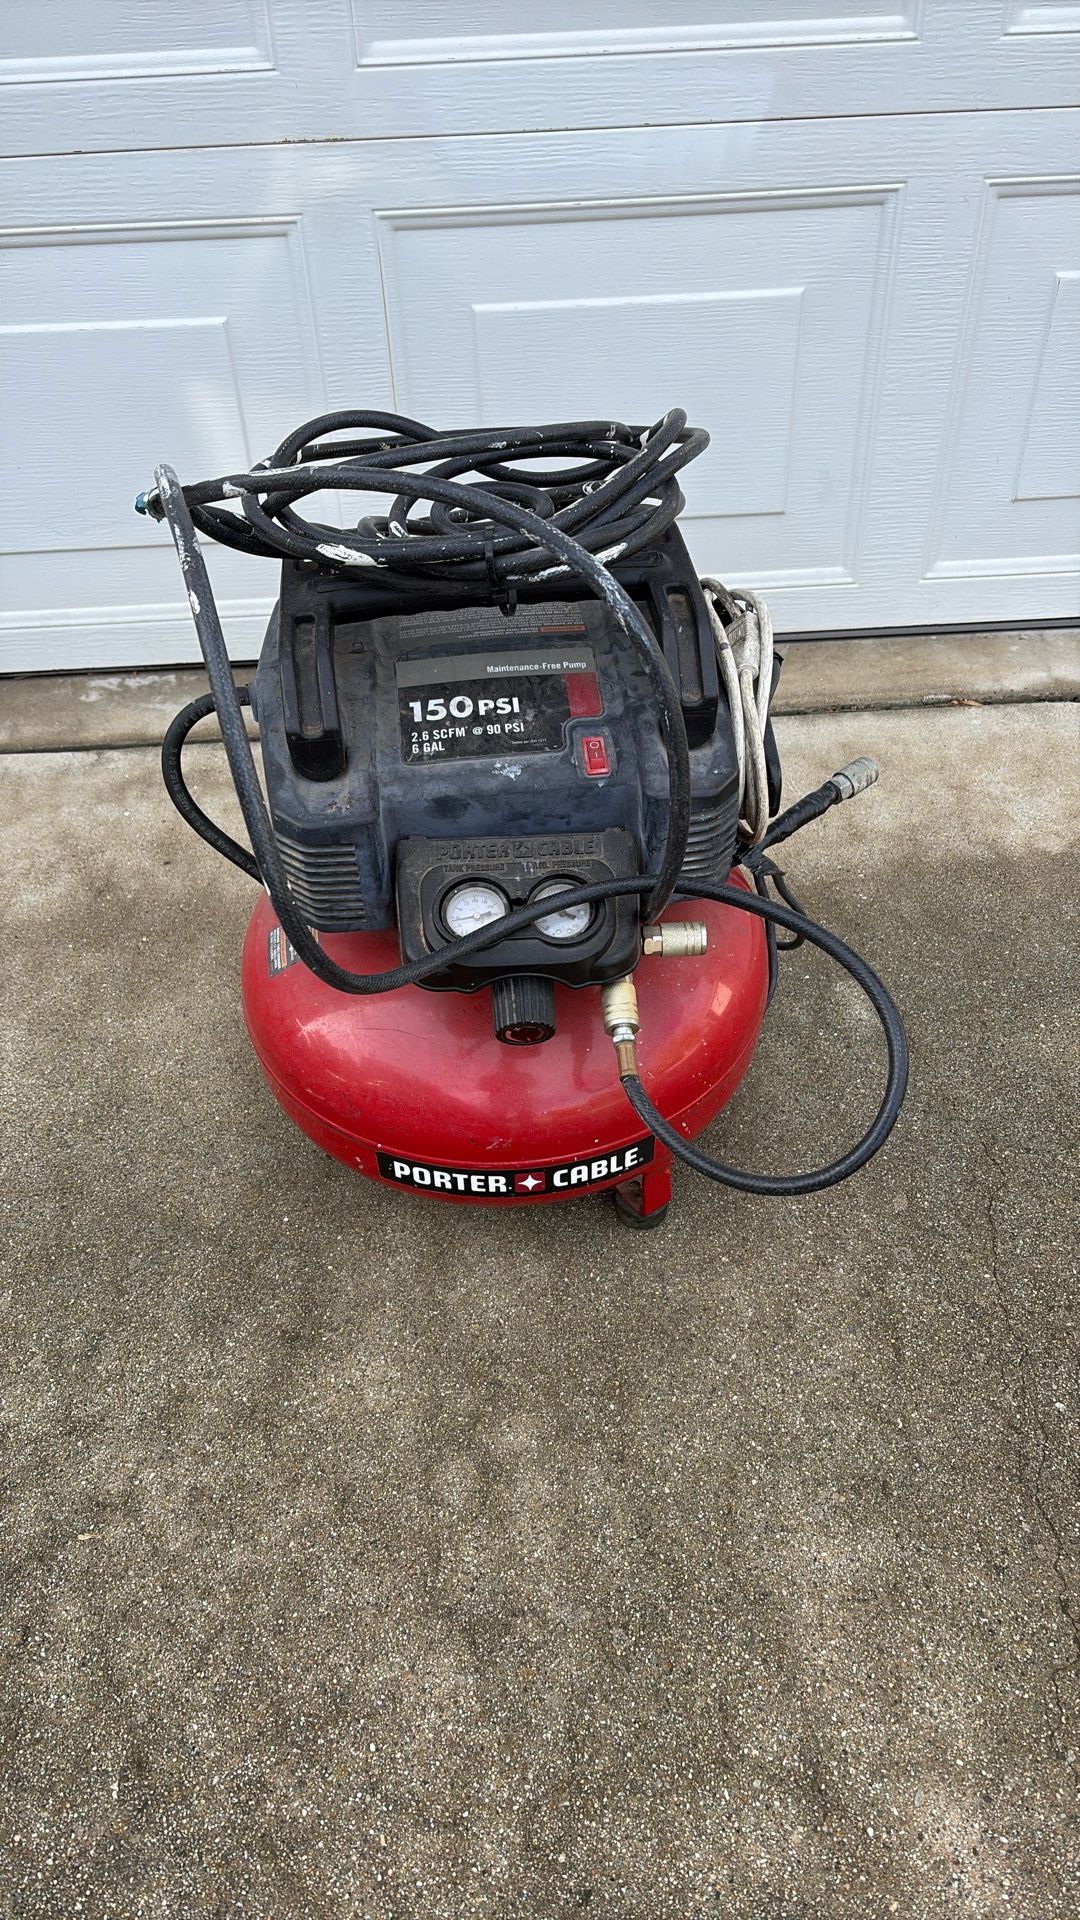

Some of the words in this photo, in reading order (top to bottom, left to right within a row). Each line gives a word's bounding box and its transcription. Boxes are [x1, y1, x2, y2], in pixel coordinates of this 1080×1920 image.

[486, 662, 561, 673] Maintenance-Free
[563, 661, 587, 671] Pump
[408, 695, 474, 722] 150
[478, 697, 520, 716] PSI
[411, 731, 429, 742] 2.6
[472, 726, 483, 736] @
[487, 724, 501, 735] 90
[505, 722, 524, 733] PSI
[412, 743, 419, 754] 6
[423, 741, 445, 752] GAL
[437, 842, 509, 860] PORTER
[537, 839, 595, 857] CABLE
[444, 864, 464, 873] TANK
[466, 863, 505, 872] PRESSURE
[552, 860, 591, 869] PRESSURE
[393, 1161, 507, 1193] PORTER
[553, 1147, 639, 1188] CABLE
